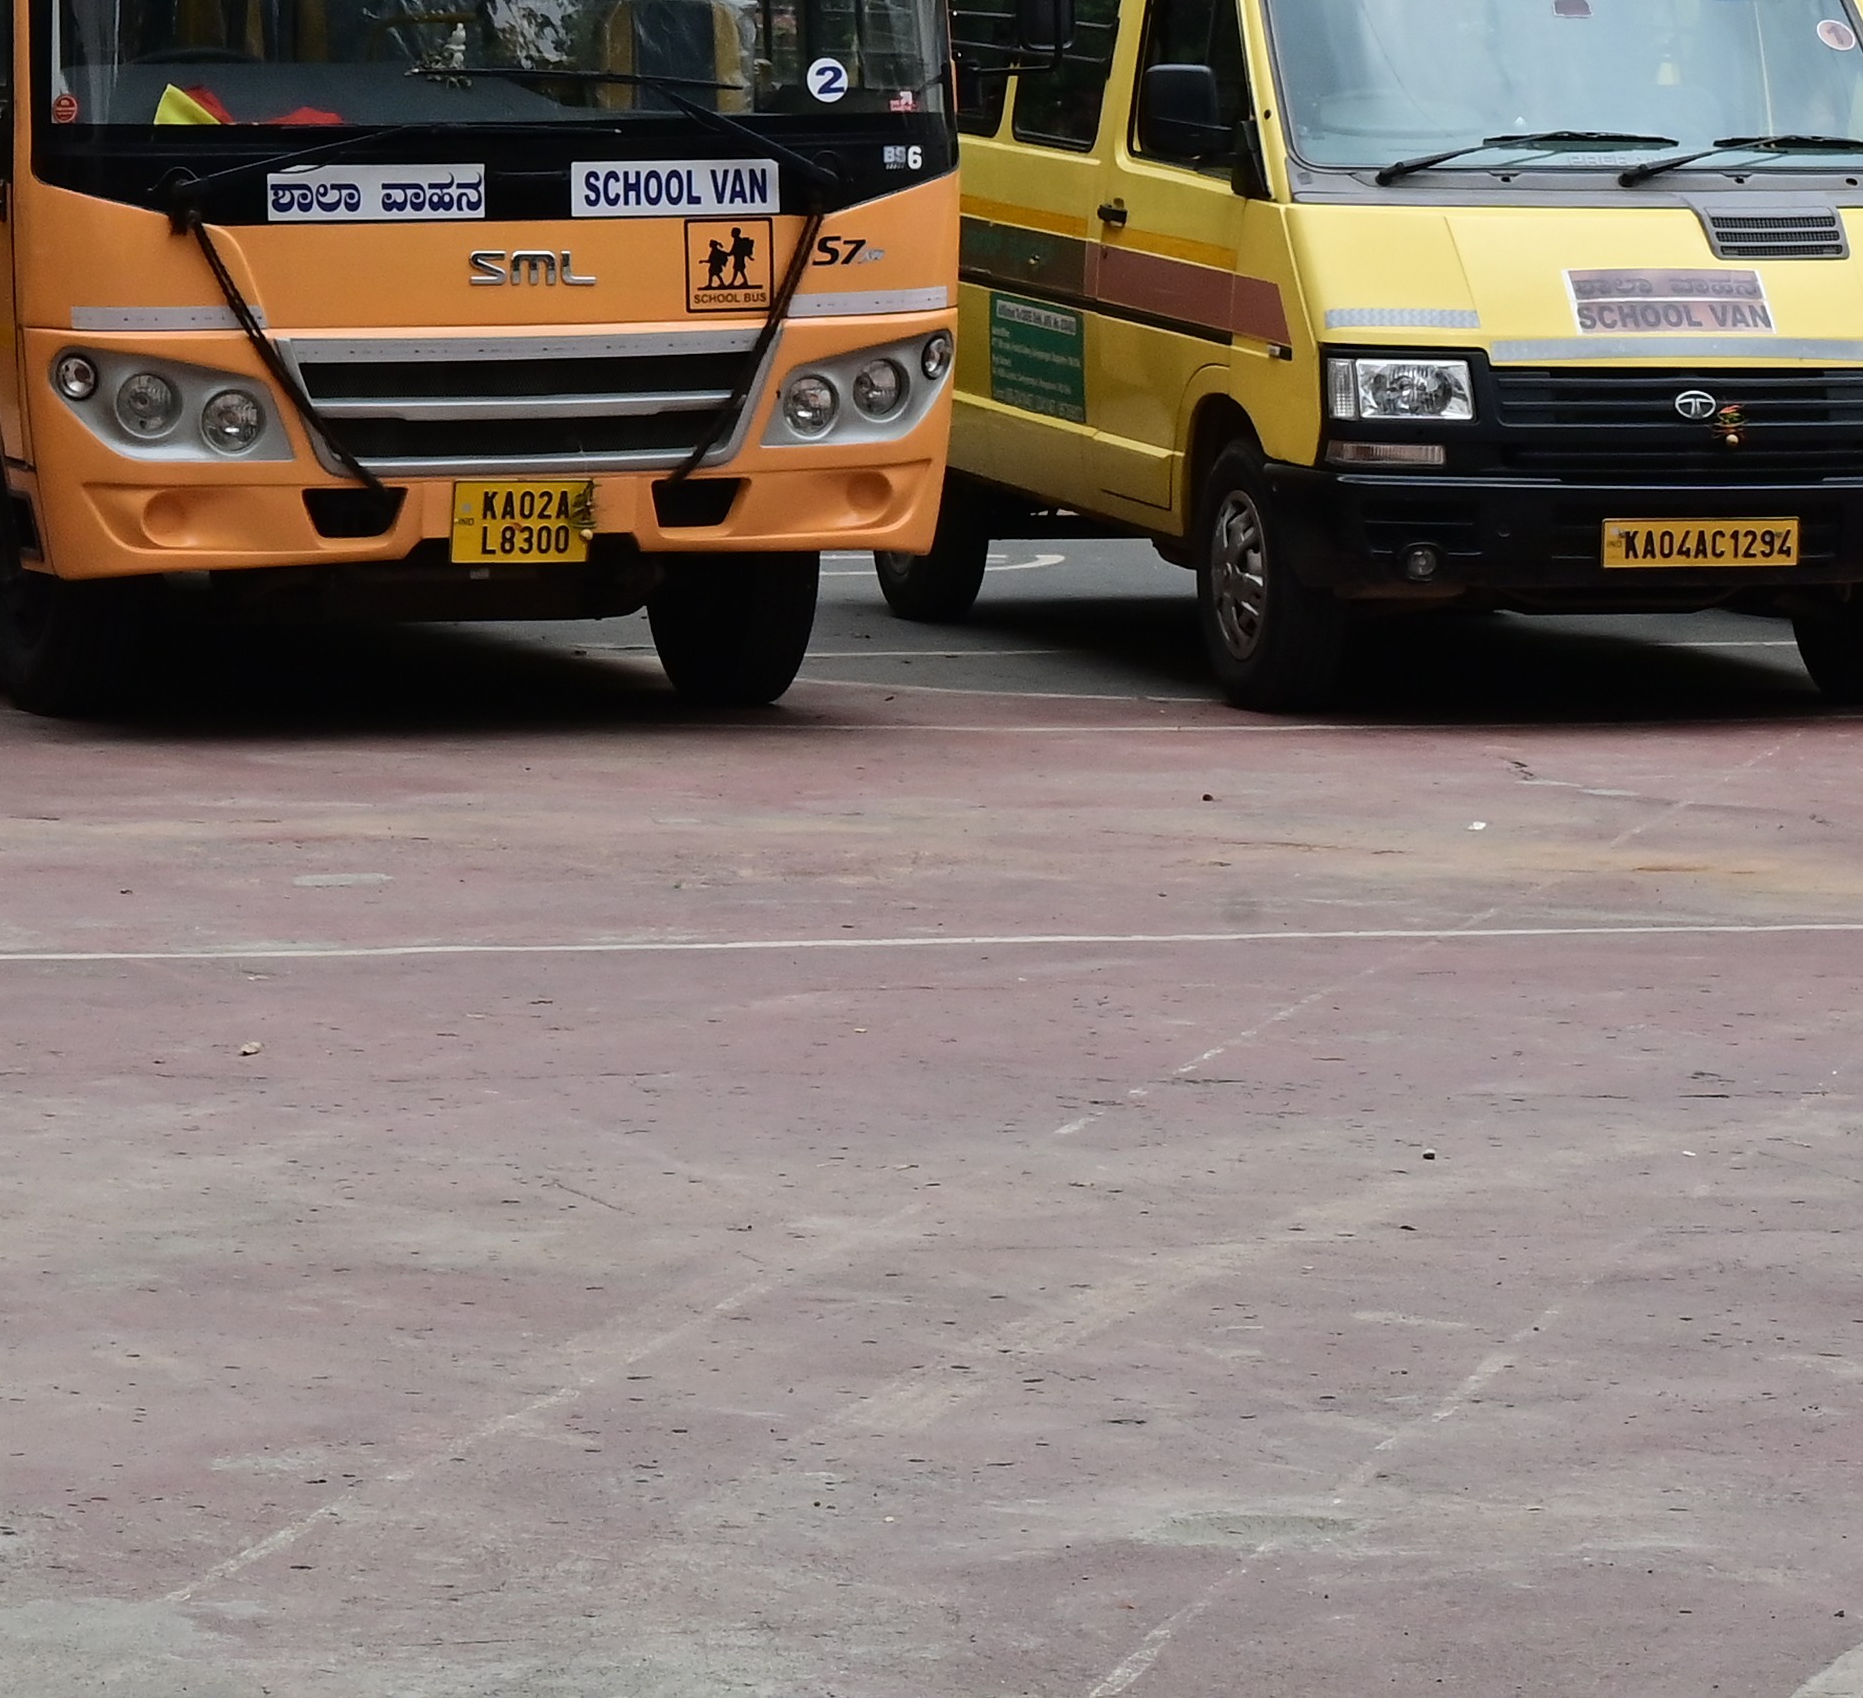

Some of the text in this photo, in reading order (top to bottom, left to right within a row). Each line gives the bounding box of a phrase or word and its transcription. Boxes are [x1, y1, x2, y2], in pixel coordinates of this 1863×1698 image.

[813, 65, 845, 95] 2
[269, 171, 483, 213] ಶಾಲಾ ವಾಹನ
[583, 167, 768, 207] SCHOOL VAN
[812, 235, 868, 266] S7
[469, 250, 597, 286] SML
[693, 292, 767, 304] SCHOOL BUS
[1577, 304, 1773, 330] SCHOOL VAN
[482, 490, 570, 520] KA02A
[481, 525, 570, 555] L8300
[1624, 529, 1792, 559] KA04AC1294
